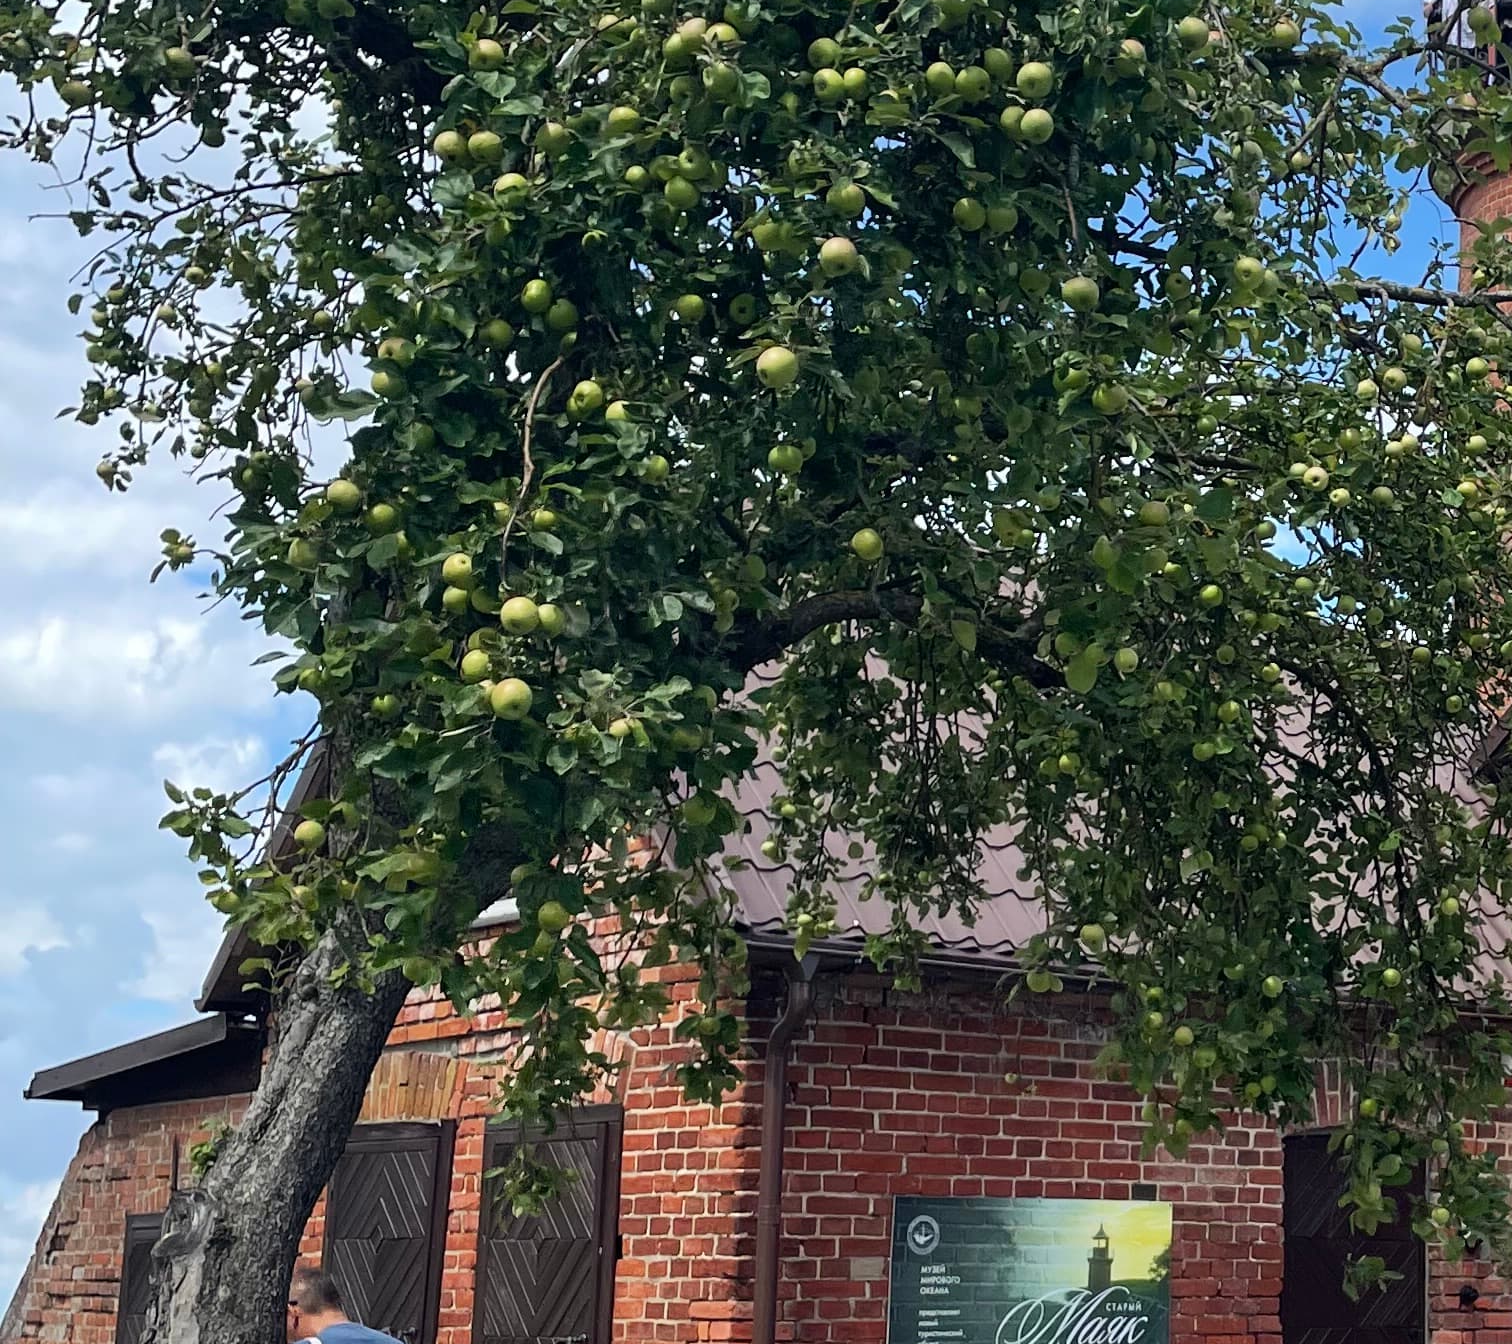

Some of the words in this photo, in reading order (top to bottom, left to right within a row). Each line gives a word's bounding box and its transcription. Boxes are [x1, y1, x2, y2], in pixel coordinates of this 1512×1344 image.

[920, 1263, 946, 1274] МУЗЕЙ
[920, 1275, 961, 1284] МИРОВОГО
[919, 1286, 950, 1295] ОКЕАНА
[1105, 1301, 1142, 1312] СТАРЫЙ
